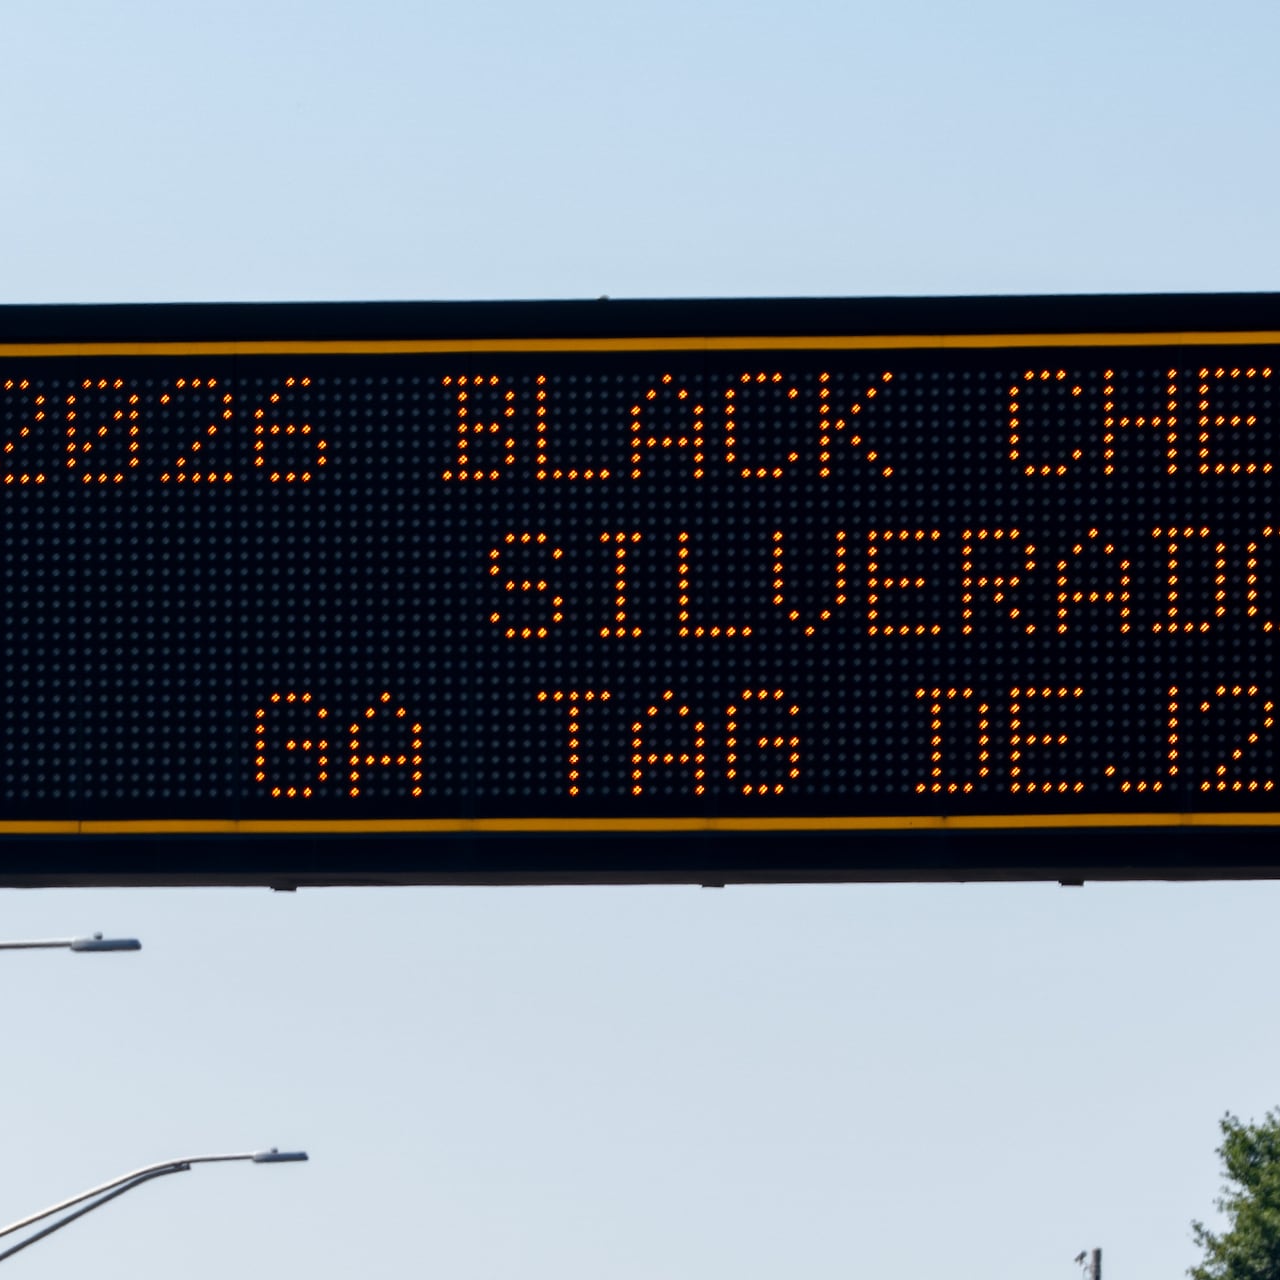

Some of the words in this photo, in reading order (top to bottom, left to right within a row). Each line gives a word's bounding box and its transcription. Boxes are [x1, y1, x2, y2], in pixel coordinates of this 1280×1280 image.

[442, 372, 893, 481] BLACK
[255, 692, 422, 798] GA
[537, 689, 800, 796] TAG
